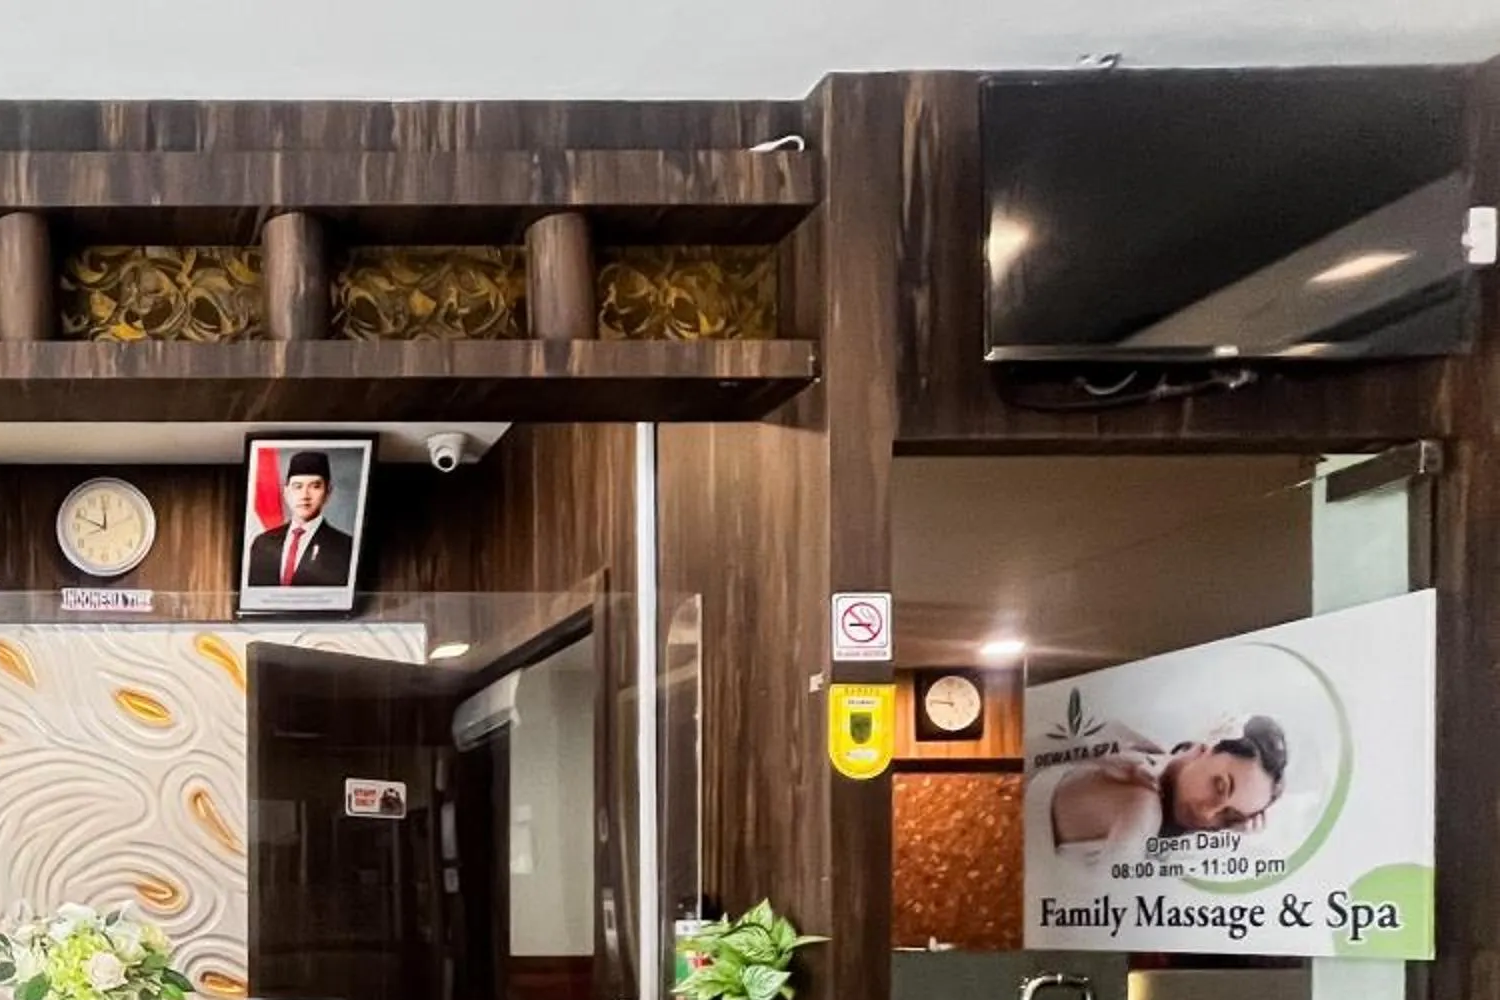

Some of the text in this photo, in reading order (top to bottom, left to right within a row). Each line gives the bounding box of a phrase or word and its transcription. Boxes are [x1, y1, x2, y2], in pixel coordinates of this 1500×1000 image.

[1033, 740, 1120, 769] DEWATA SPA
[1146, 832, 1242, 857] Open Daily
[1111, 861, 1155, 879] 08:00
[1158, 864, 1184, 877] am
[1201, 858, 1249, 876] 11:00
[1255, 857, 1286, 877] pm
[1039, 890, 1402, 941] Family Massage & Spa
